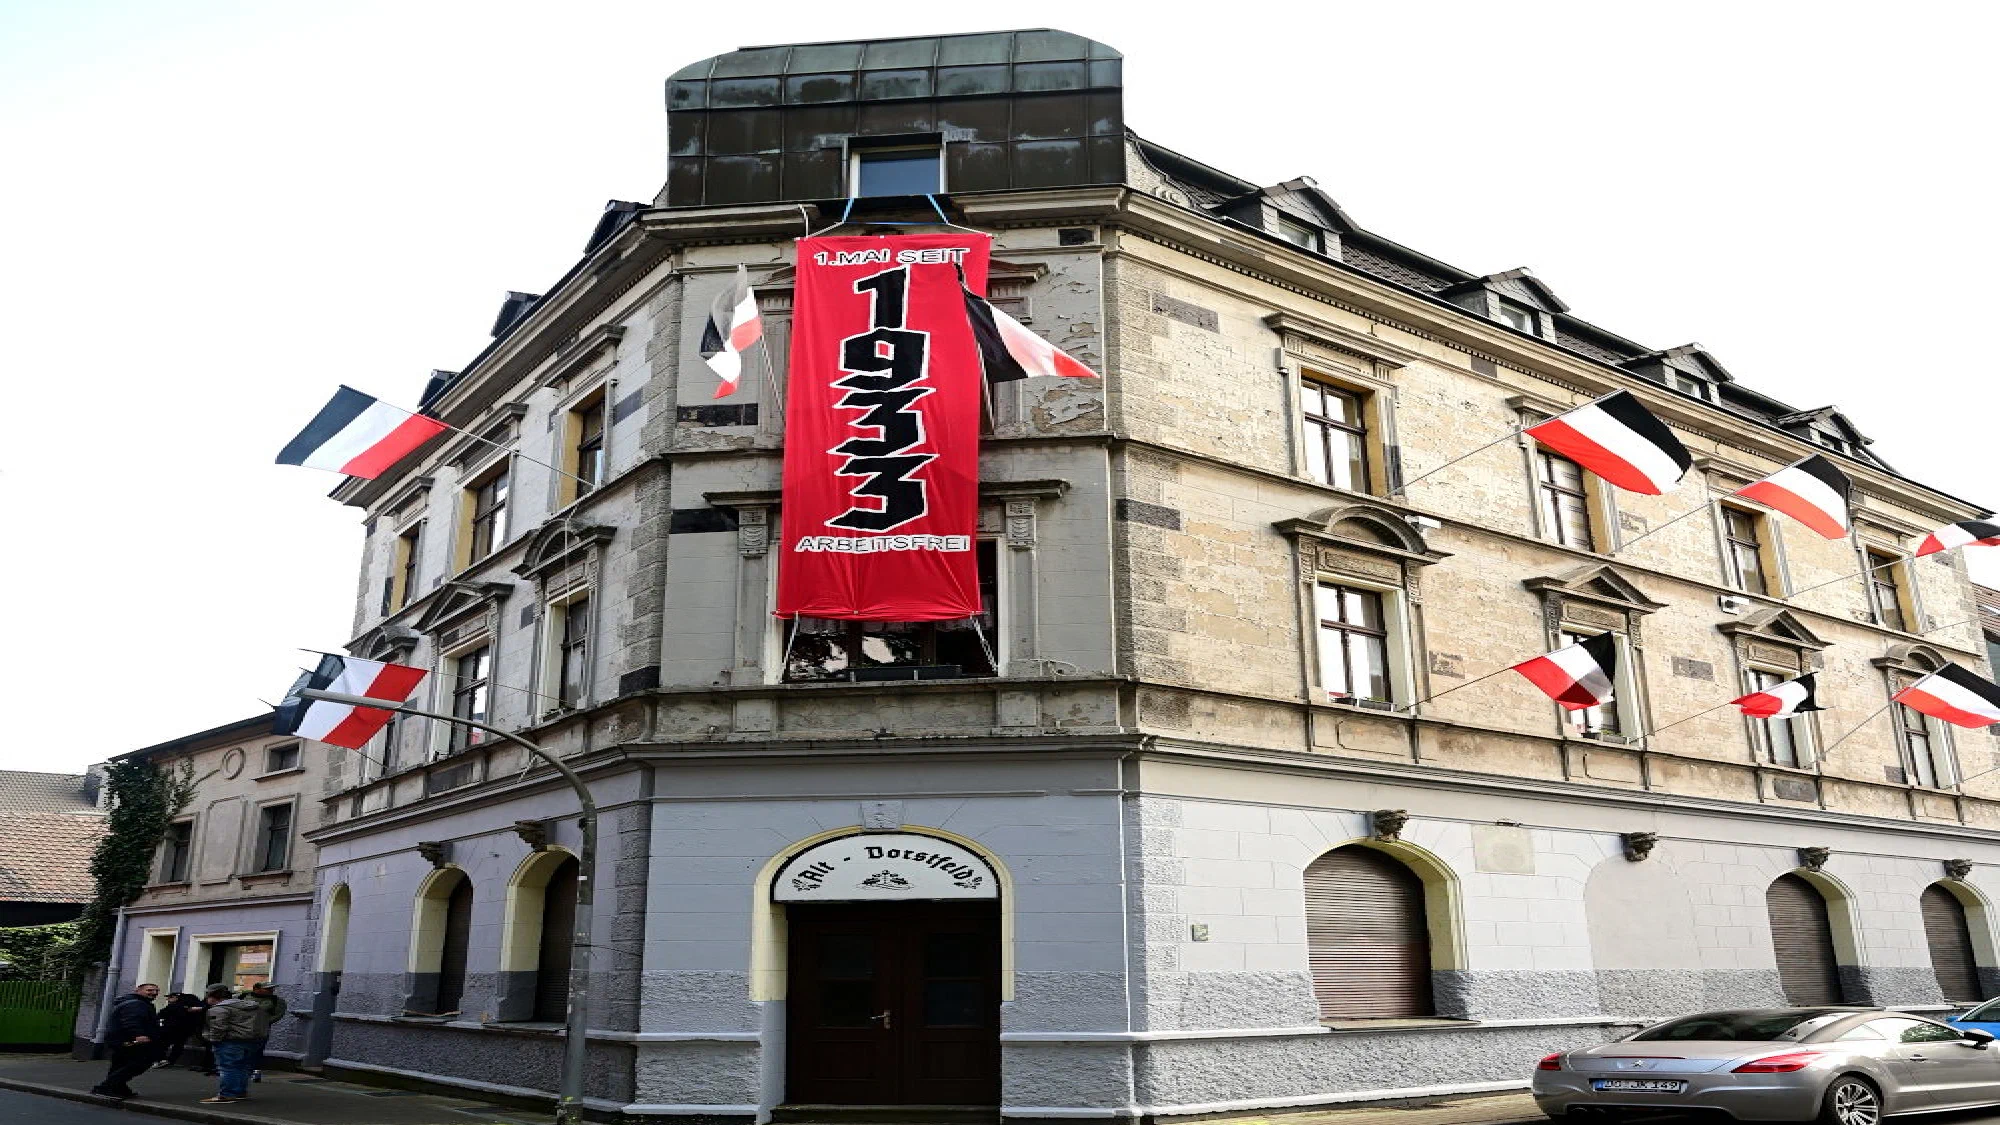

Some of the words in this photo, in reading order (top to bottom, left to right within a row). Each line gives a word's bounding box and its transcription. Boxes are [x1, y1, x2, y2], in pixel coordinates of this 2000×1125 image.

[896, 248, 970, 264] SEIT
[824, 265, 940, 532] 1933
[795, 535, 971, 553] ARBEITSFREI
[798, 861, 835, 883] Alt
[864, 846, 974, 880] Dorstfeld
